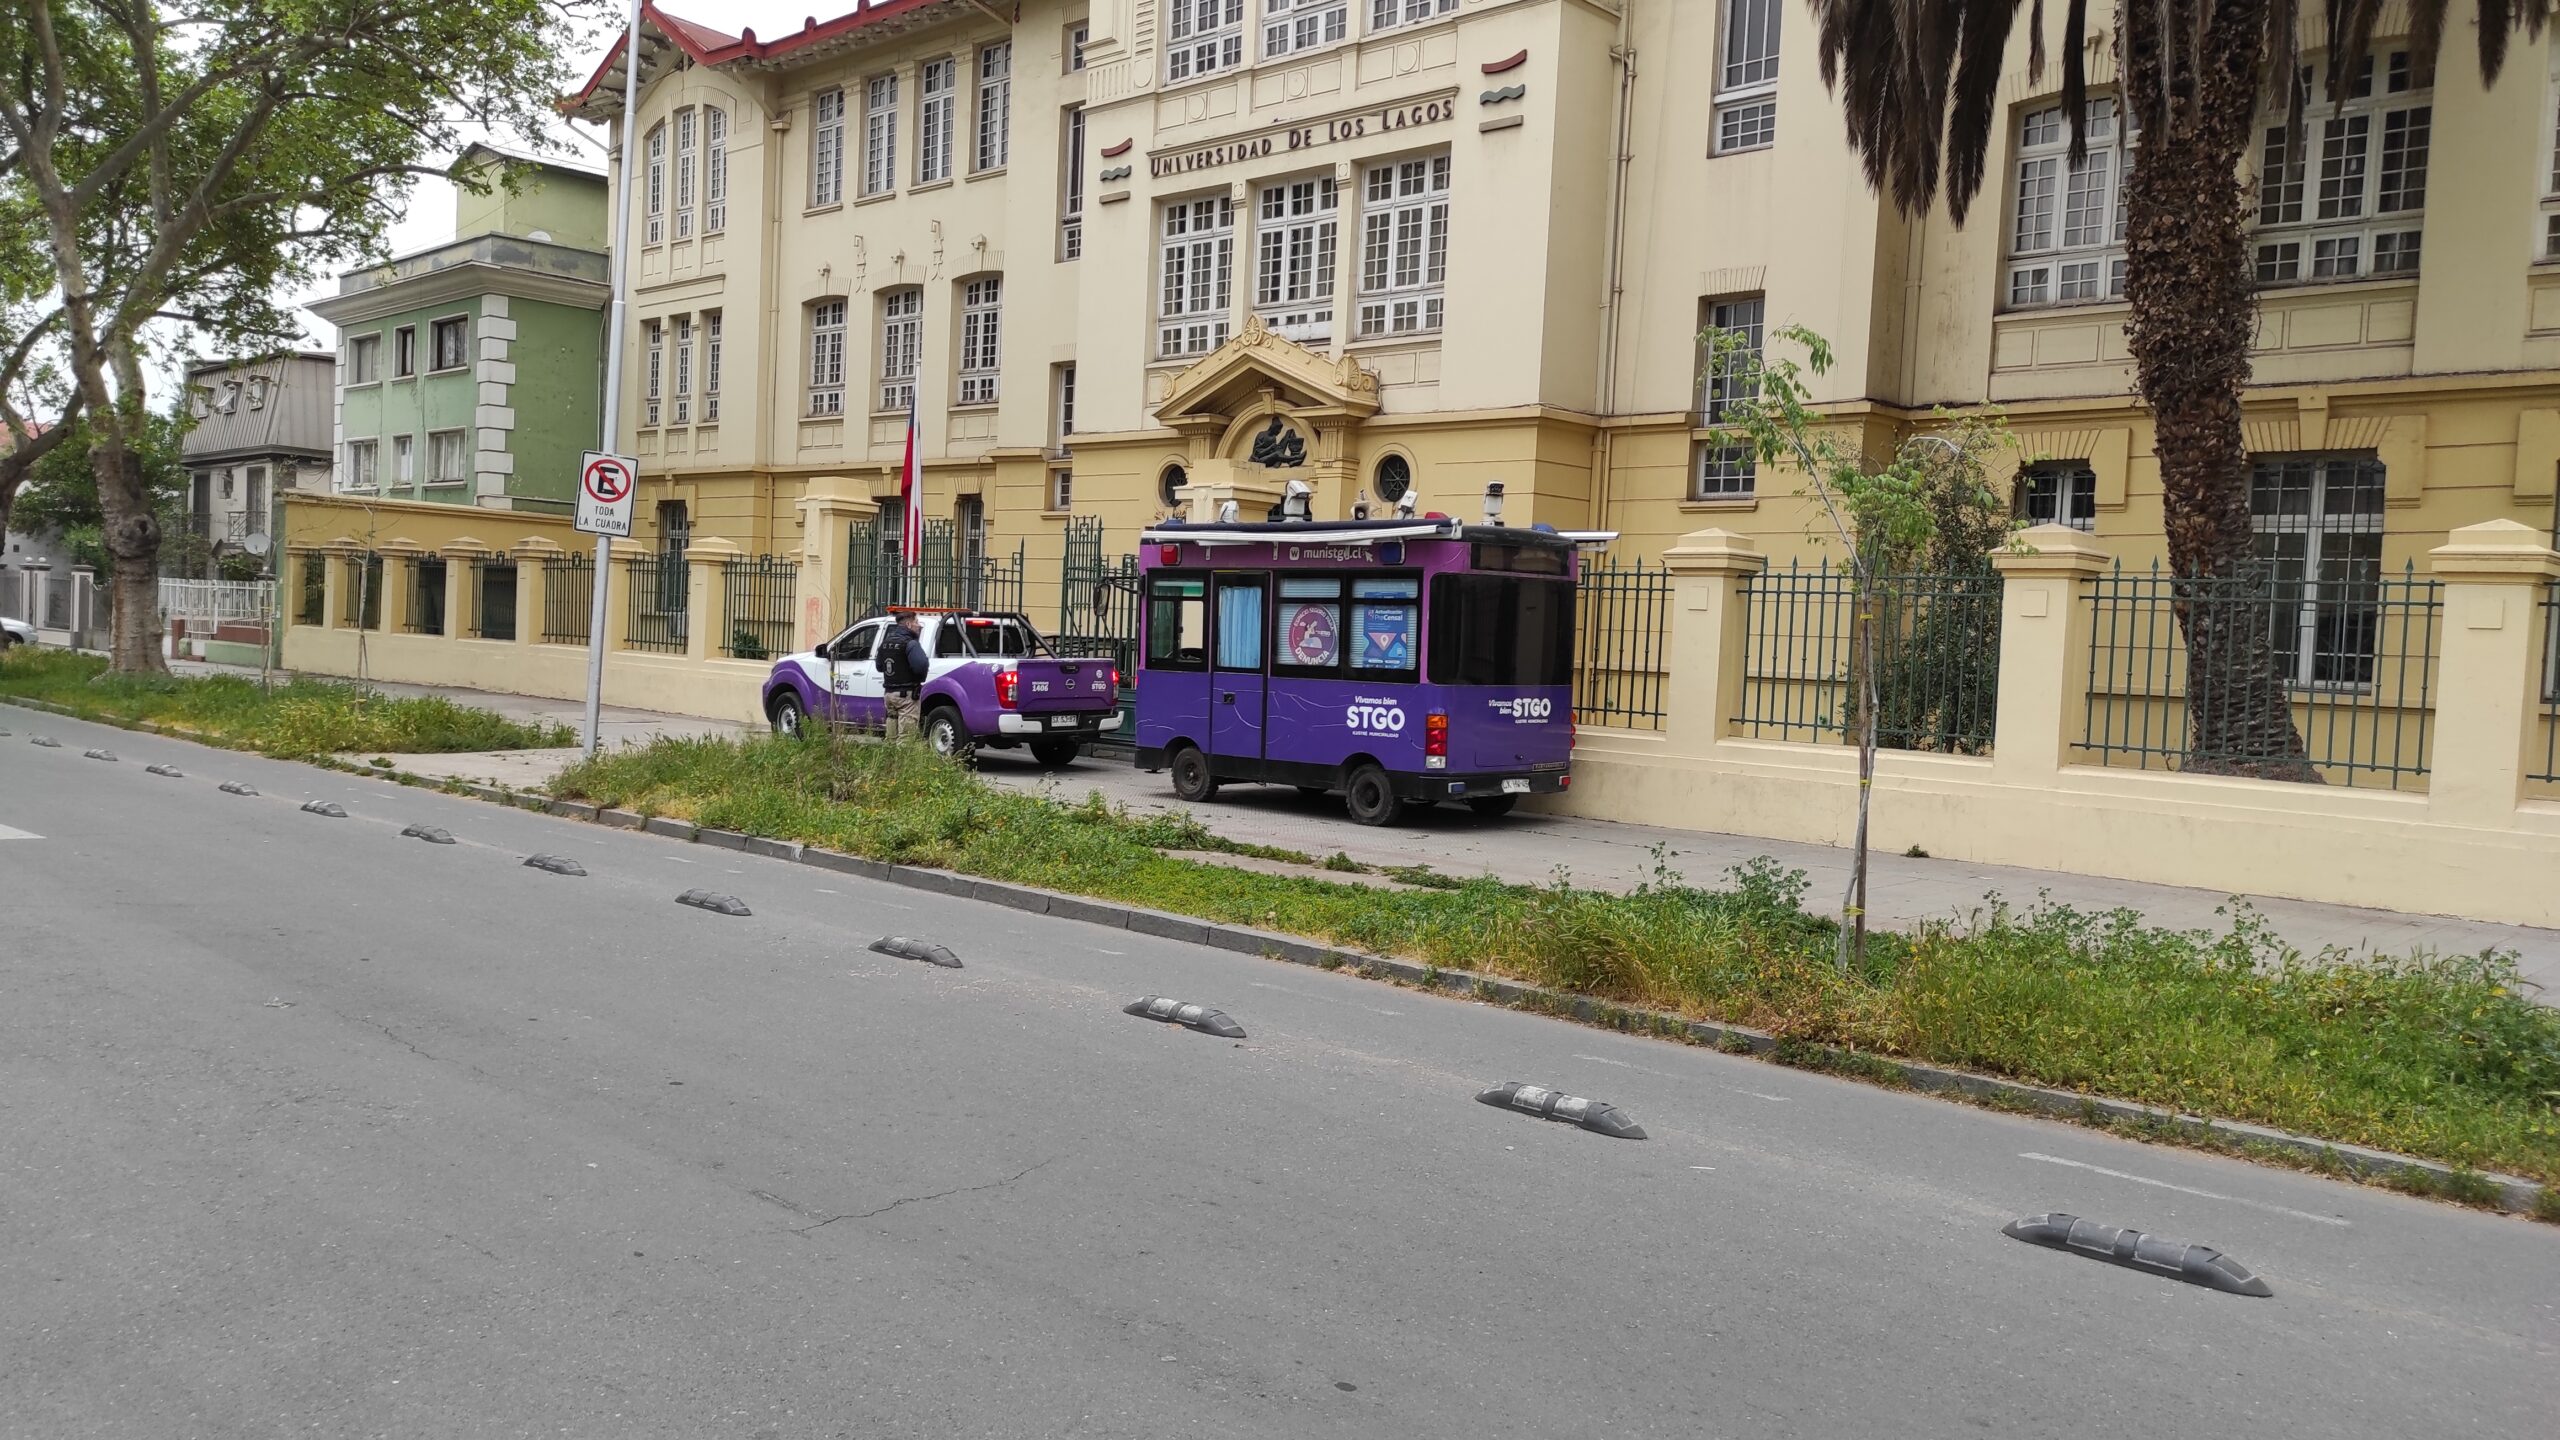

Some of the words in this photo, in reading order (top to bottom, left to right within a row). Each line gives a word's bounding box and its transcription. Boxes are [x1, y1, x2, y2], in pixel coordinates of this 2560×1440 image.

[1150, 137, 1272, 177] UNIVERSIDAD
[1288, 128, 1312, 149] DE
[1328, 120, 1365, 142] LOS
[1382, 99, 1453, 131] LAGOS
[595, 505, 615, 517] TODA
[578, 516, 589, 526] LA
[595, 518, 627, 531] CUADRA
[1295, 646, 1330, 665] DENUNCIA
[832, 680, 850, 691] 406
[1032, 684, 1049, 692] 1406
[1355, 695, 1382, 704] Vivamos
[1382, 697, 1397, 705] bien
[1512, 698, 1551, 718] STGO
[1346, 705, 1406, 731] STGO
